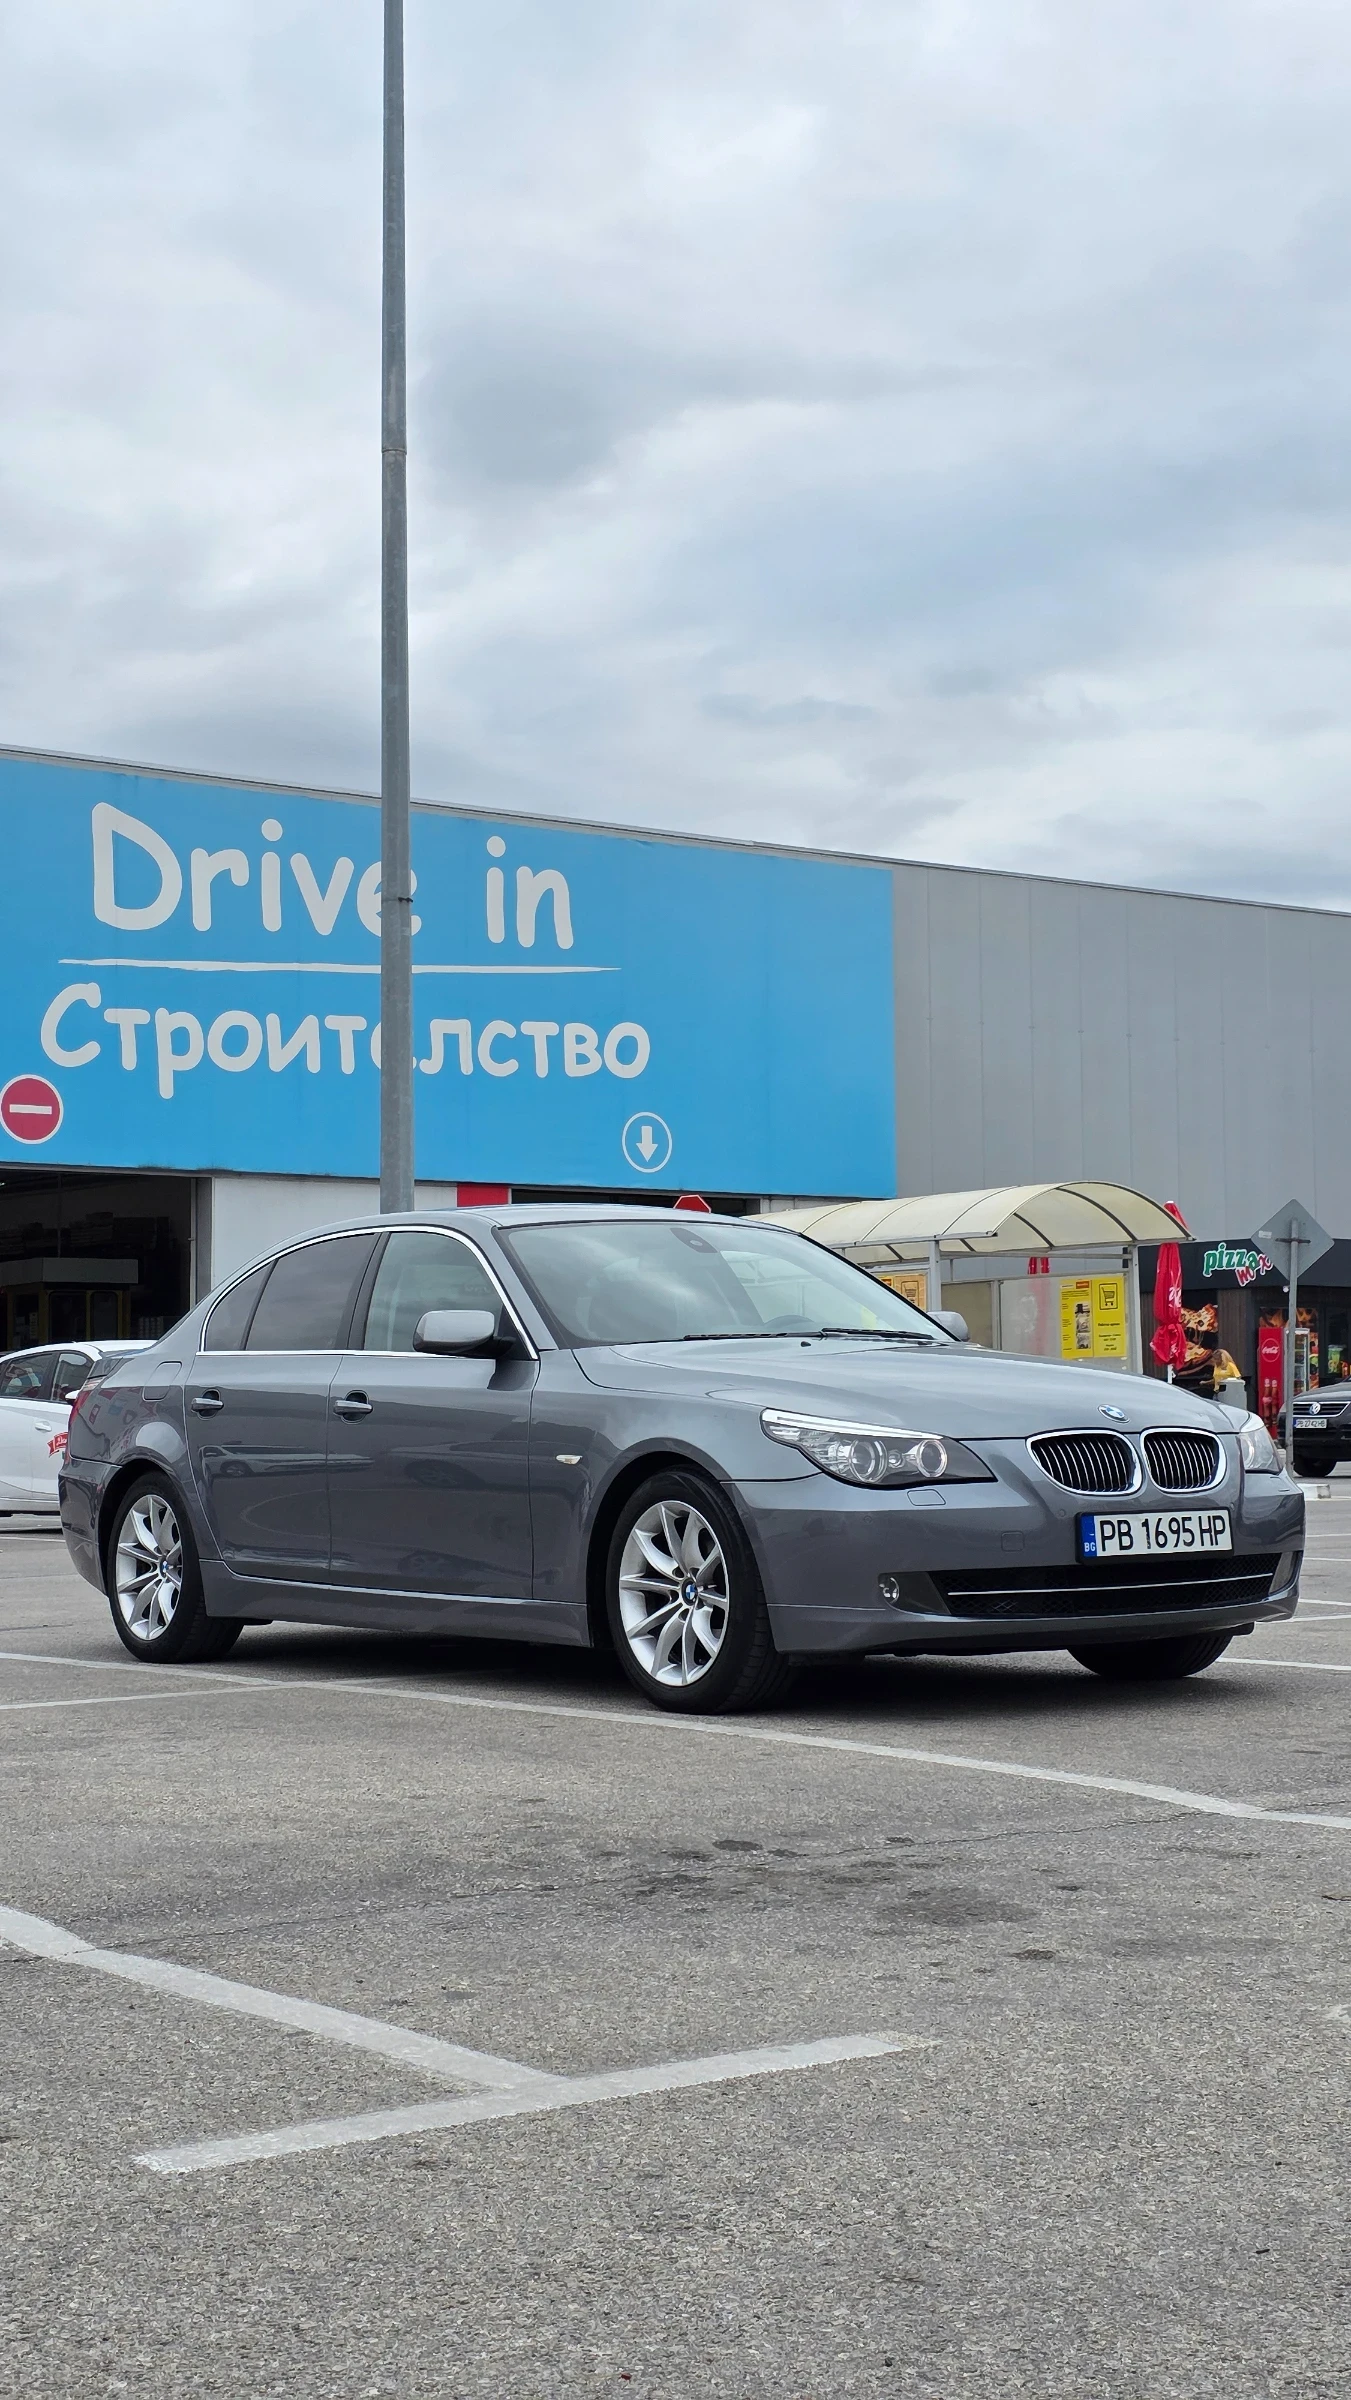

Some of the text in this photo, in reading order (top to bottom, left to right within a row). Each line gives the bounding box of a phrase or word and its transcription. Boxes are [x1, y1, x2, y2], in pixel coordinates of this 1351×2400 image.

[486, 835, 574, 950] in
[41, 981, 651, 1100] Строитлство
[1203, 1242, 1260, 1277] pizza
[1084, 1541, 1096, 1552] BG
[1099, 1515, 1226, 1552] PB 1695 HP
